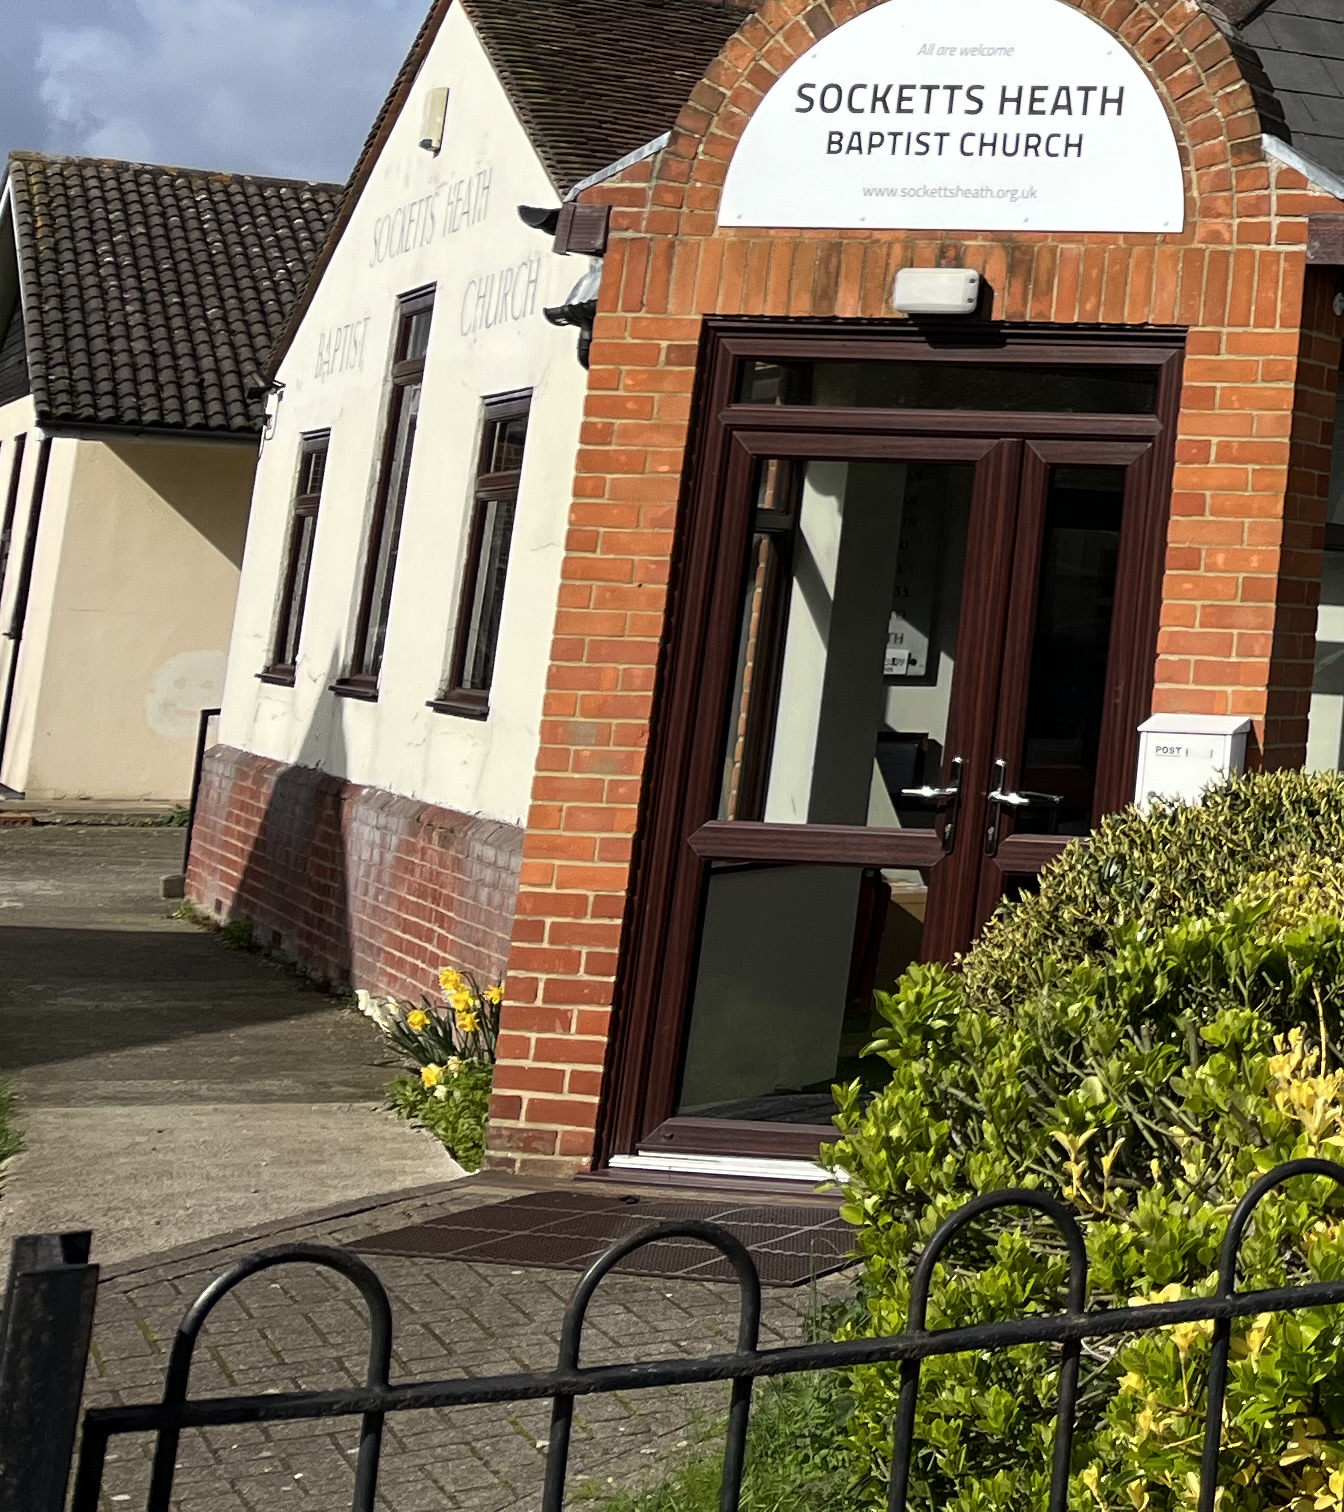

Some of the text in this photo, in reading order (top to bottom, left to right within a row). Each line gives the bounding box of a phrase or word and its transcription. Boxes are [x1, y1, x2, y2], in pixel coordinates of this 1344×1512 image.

[916, 43, 1016, 57] All are welcome
[794, 82, 1125, 117] SOCKETTS HEATH
[825, 130, 1084, 159] BAPTIST CHURCH
[862, 184, 1038, 203] www.sockettsheath.org.uk
[369, 166, 493, 268] SOCKETTS HEATH
[315, 256, 541, 379] BAPTIST CHURCH
[1155, 746, 1182, 755] POST
